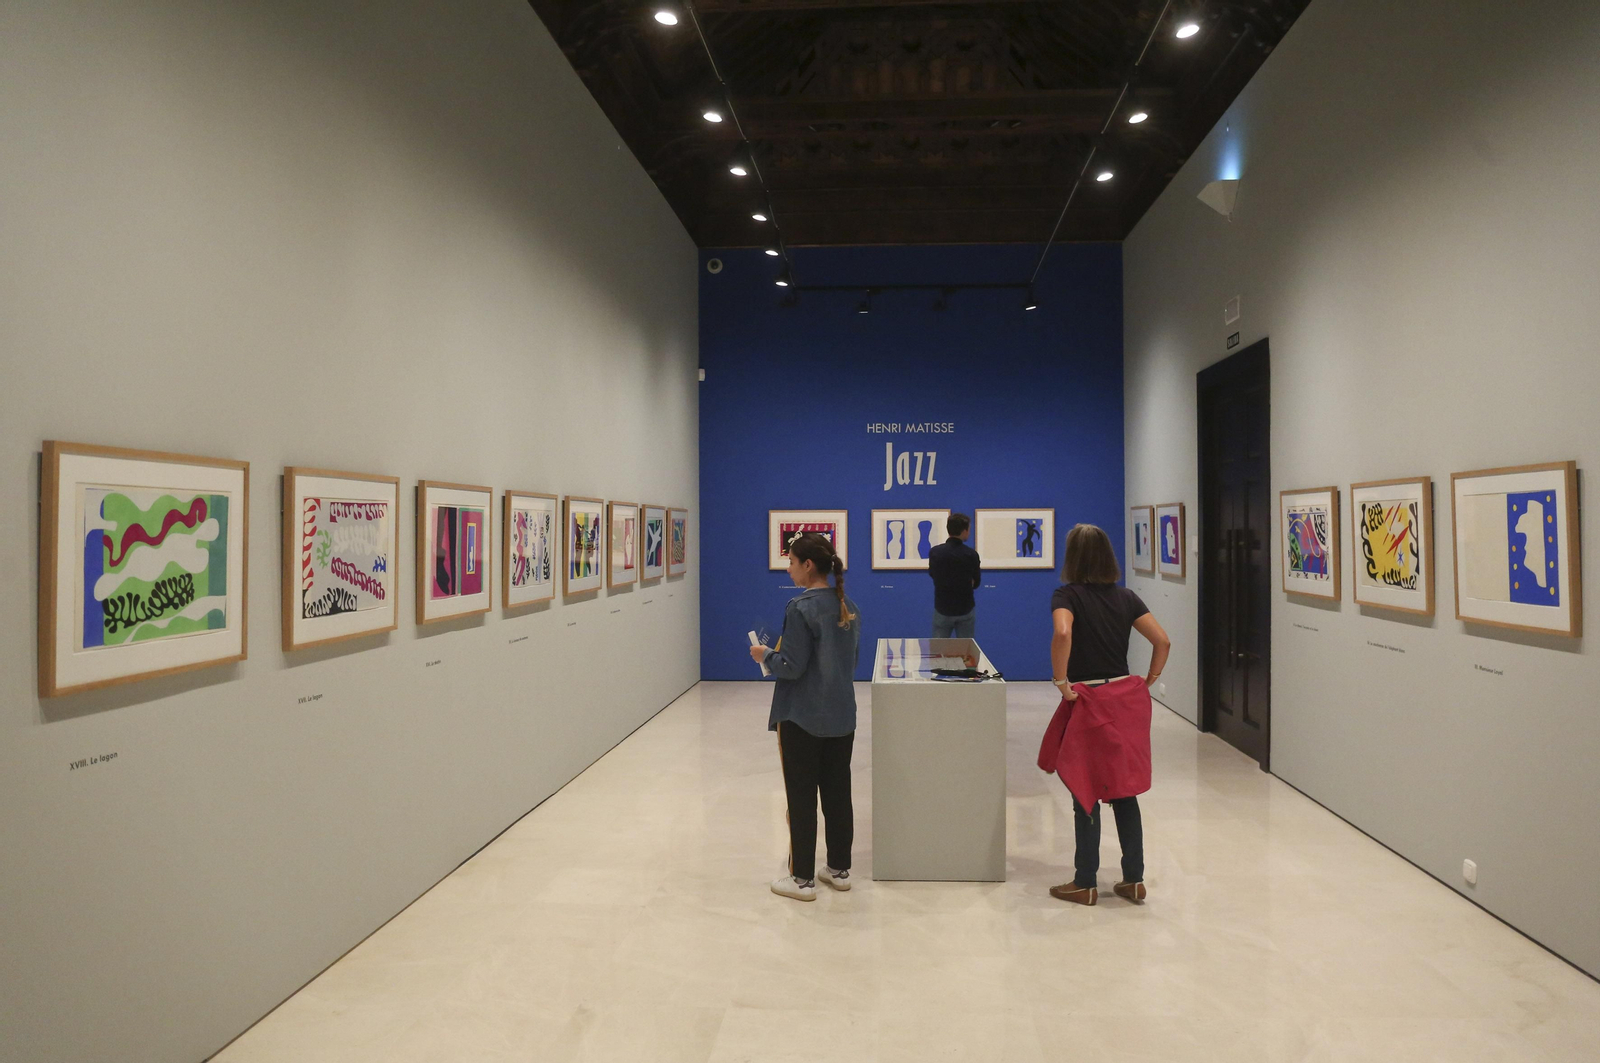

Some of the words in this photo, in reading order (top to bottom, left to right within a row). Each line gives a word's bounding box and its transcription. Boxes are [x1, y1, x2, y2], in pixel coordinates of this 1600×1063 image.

[867, 423, 901, 433] HENRI
[905, 422, 955, 433] MATISSE
[883, 442, 937, 491] Jazz
[69, 758, 89, 771] XVIII.
[90, 757, 98, 765] Le
[99, 752, 118, 762] lagon
